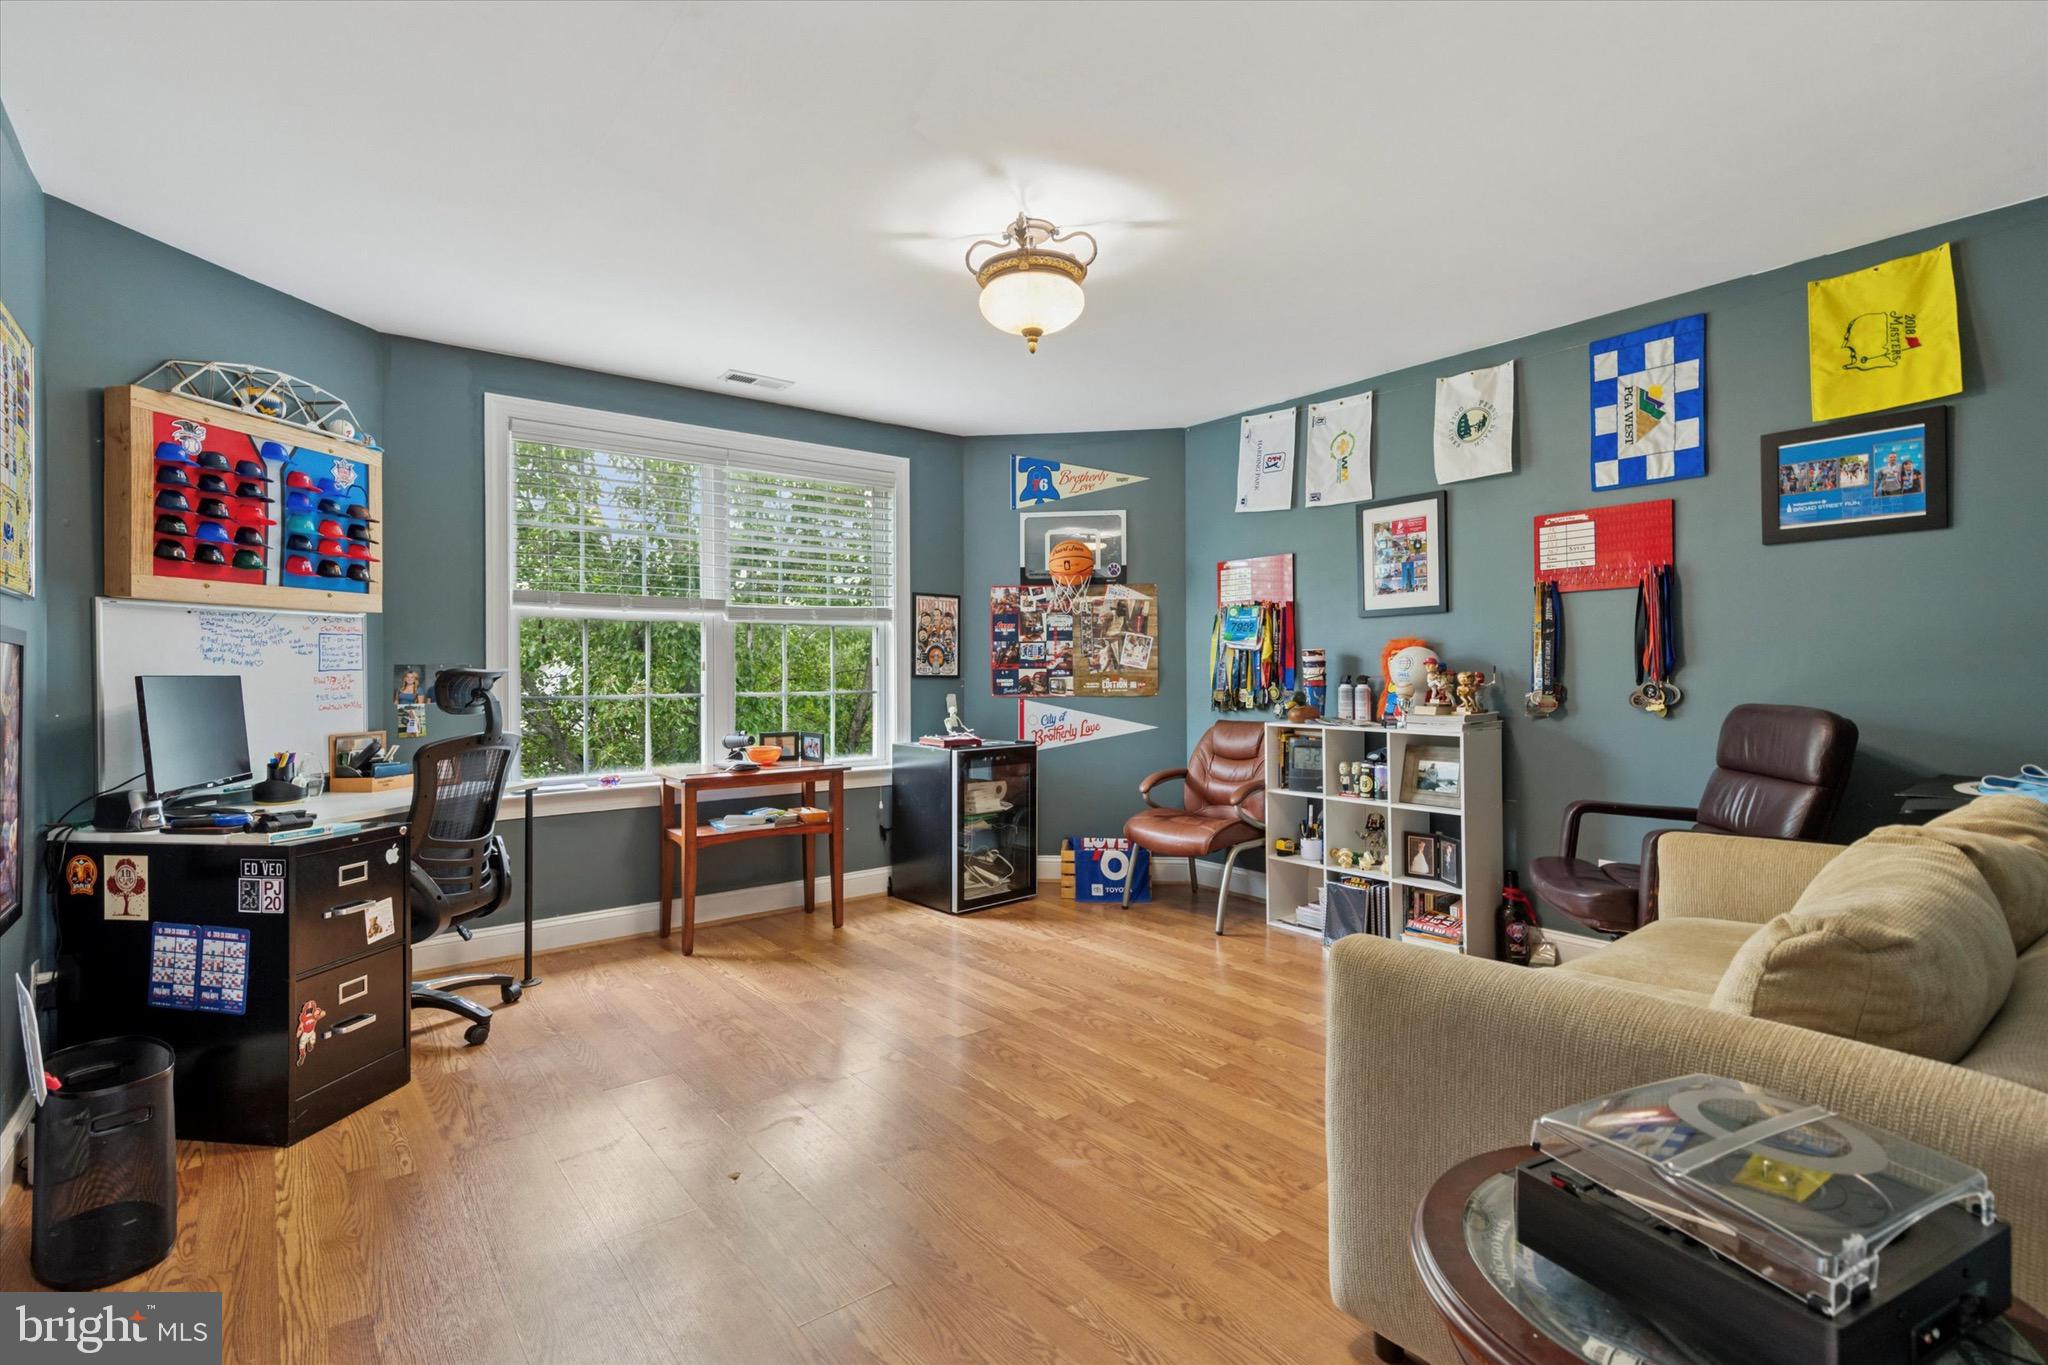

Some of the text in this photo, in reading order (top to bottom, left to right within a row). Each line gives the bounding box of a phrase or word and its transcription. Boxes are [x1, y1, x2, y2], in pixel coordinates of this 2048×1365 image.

[1905, 313, 1916, 335] 2018
[1624, 386, 1634, 445] PGA WEST
[1059, 469, 1108, 486] Brotherly
[1069, 482, 1095, 494] Love
[1040, 710, 1068, 729] City of
[1031, 719, 1101, 747] Brotherly Love
[1083, 837, 1129, 848] LOVE
[244, 862, 283, 876] ED VED
[241, 881, 258, 896] PJ
[264, 881, 282, 896] PJ
[241, 895, 258, 909] 20
[264, 896, 282, 911] 20
